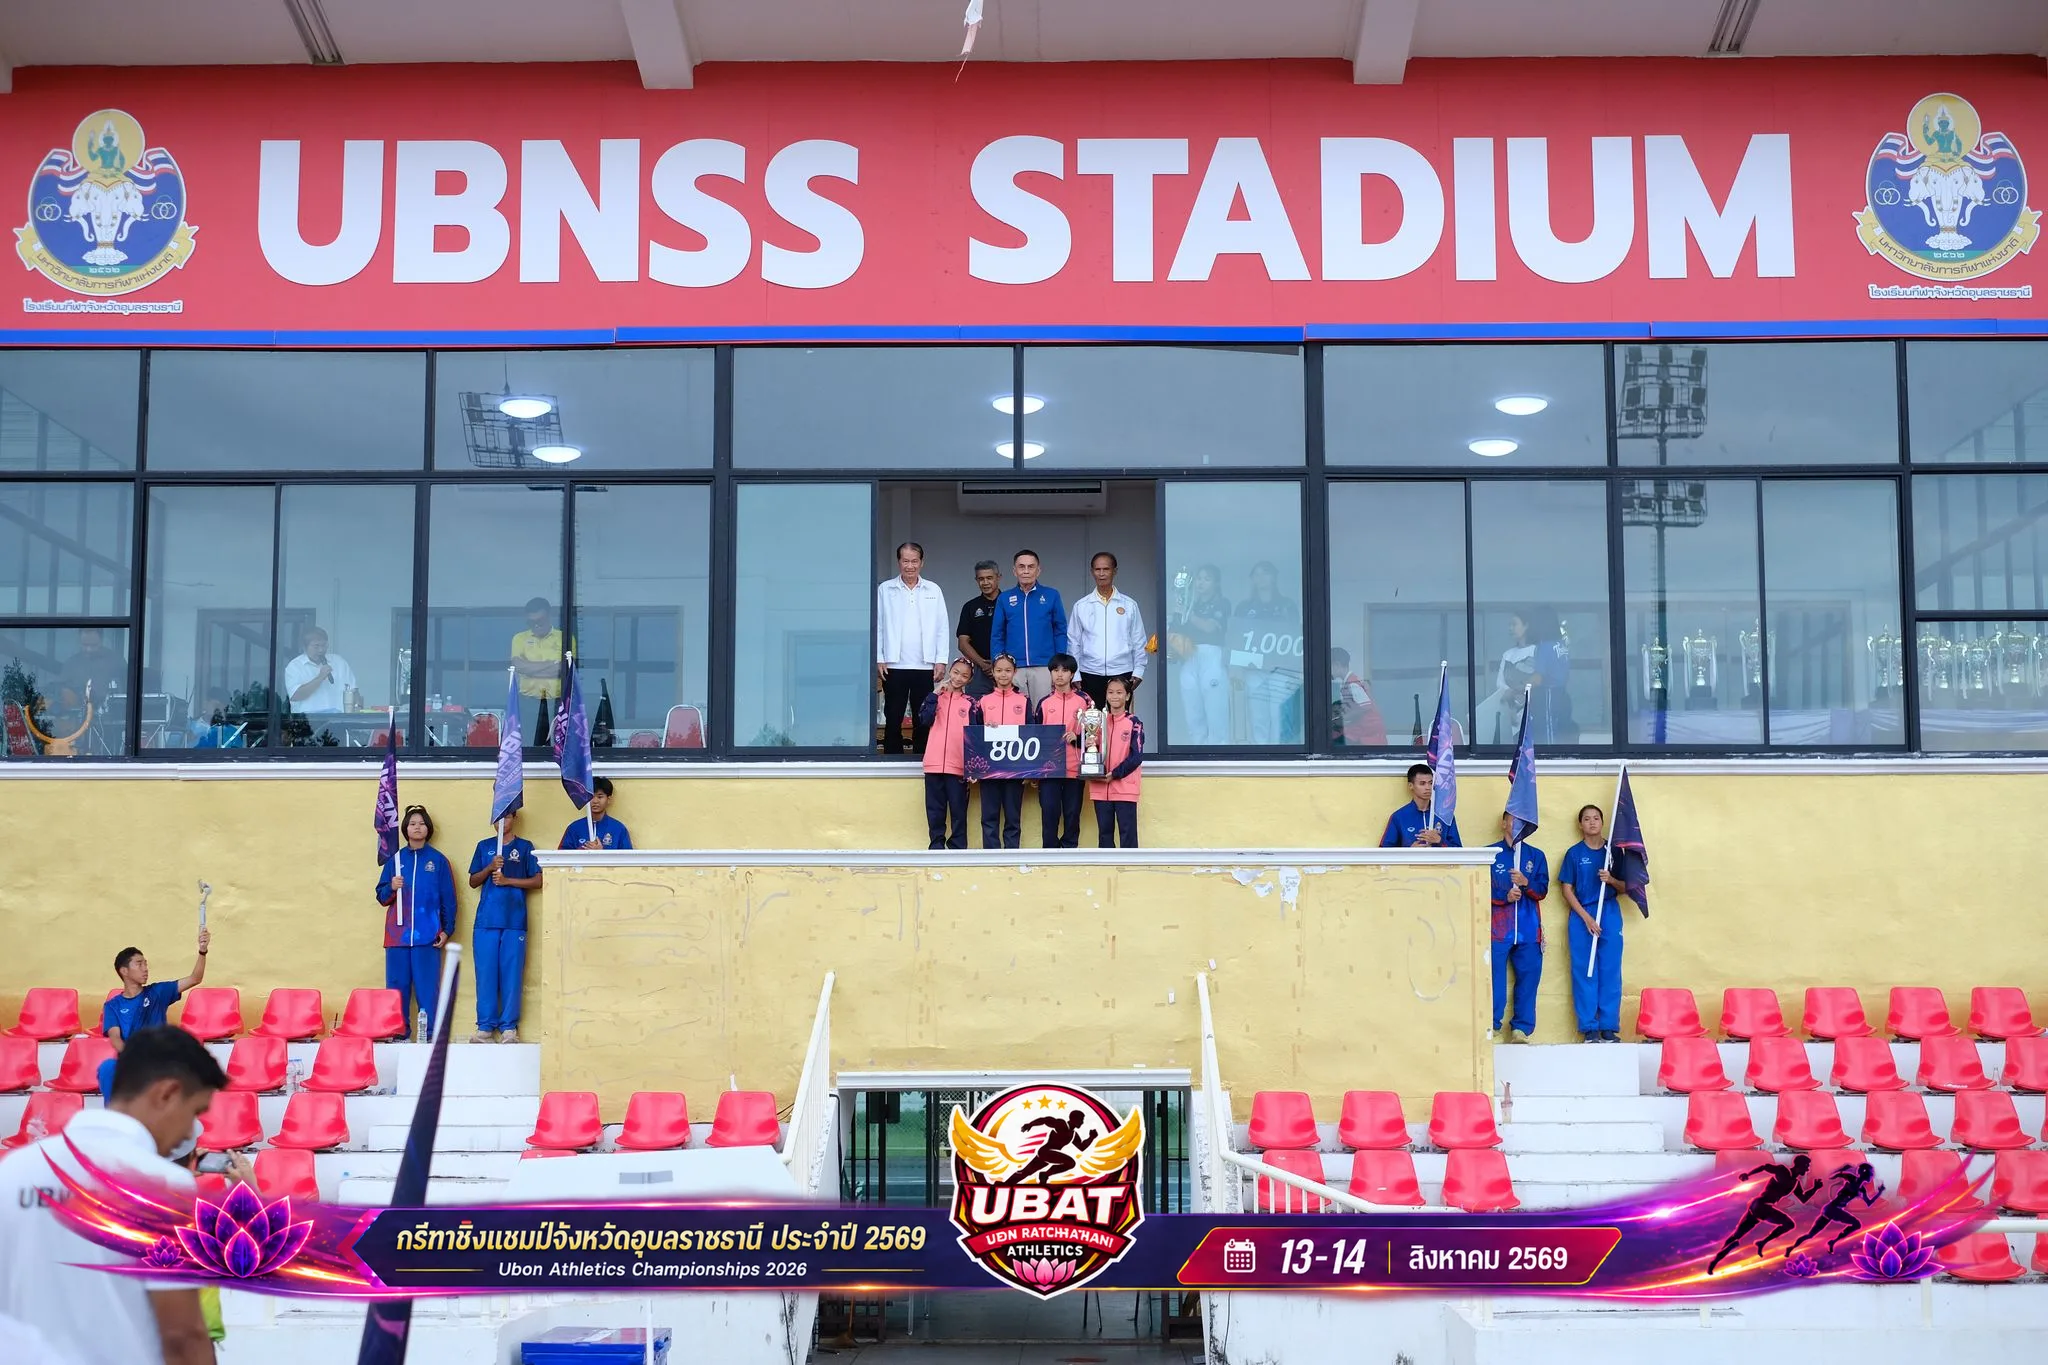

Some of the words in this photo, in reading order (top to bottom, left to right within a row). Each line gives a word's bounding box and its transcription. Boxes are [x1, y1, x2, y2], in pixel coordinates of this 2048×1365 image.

[258, 138, 865, 289] UBNSS
[968, 134, 1796, 285] STADIUM
[989, 736, 1041, 762] 800
